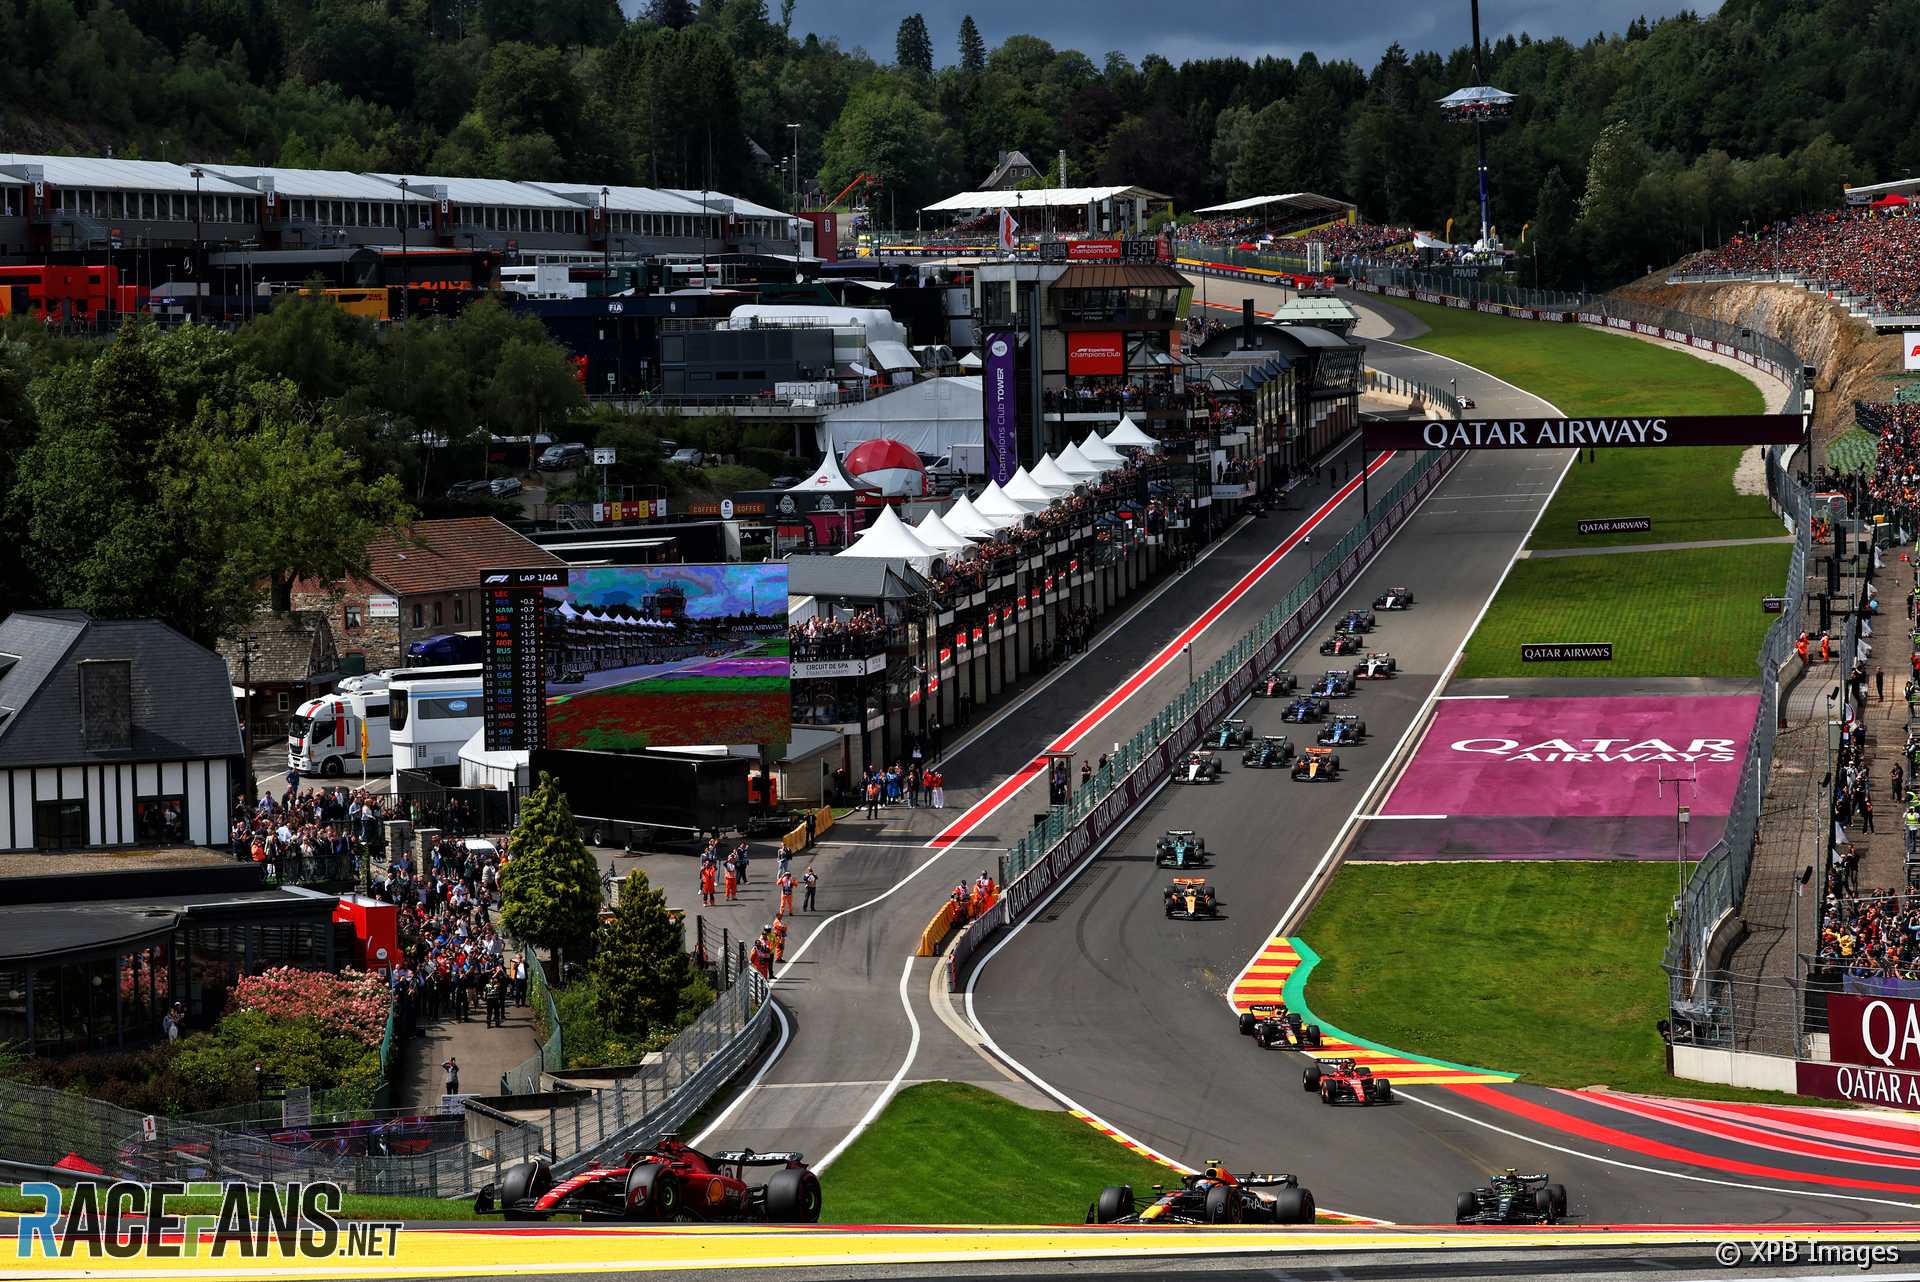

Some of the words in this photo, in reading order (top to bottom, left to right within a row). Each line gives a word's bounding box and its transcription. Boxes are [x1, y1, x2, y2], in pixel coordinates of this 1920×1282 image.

[1452, 268, 1479, 278] PMR
[608, 303, 623, 313] FIA
[997, 403, 1006, 425] Club
[1423, 422, 1528, 449] QATAR
[1536, 419, 1668, 446] AIRWAYS
[998, 427, 1007, 482] Champions
[693, 505, 718, 513] COFFEE
[736, 505, 761, 513] COFFEE
[1580, 522, 1610, 533] QATAR
[1612, 520, 1649, 530] AIRWAYS
[519, 574, 535, 582] LAP
[537, 573, 558, 582] 1/44
[1524, 649, 1561, 659] QATAR
[1563, 647, 1610, 658] AIRWAYS
[1451, 738, 1736, 754] QATAR
[1506, 752, 1735, 762] AIRWAYS
[1008, 878, 1029, 919] QATAR
[1028, 859, 1052, 902] AIRWAYS
[1862, 1000, 1920, 1067] QA
[1836, 1067, 1903, 1104] QATAR
